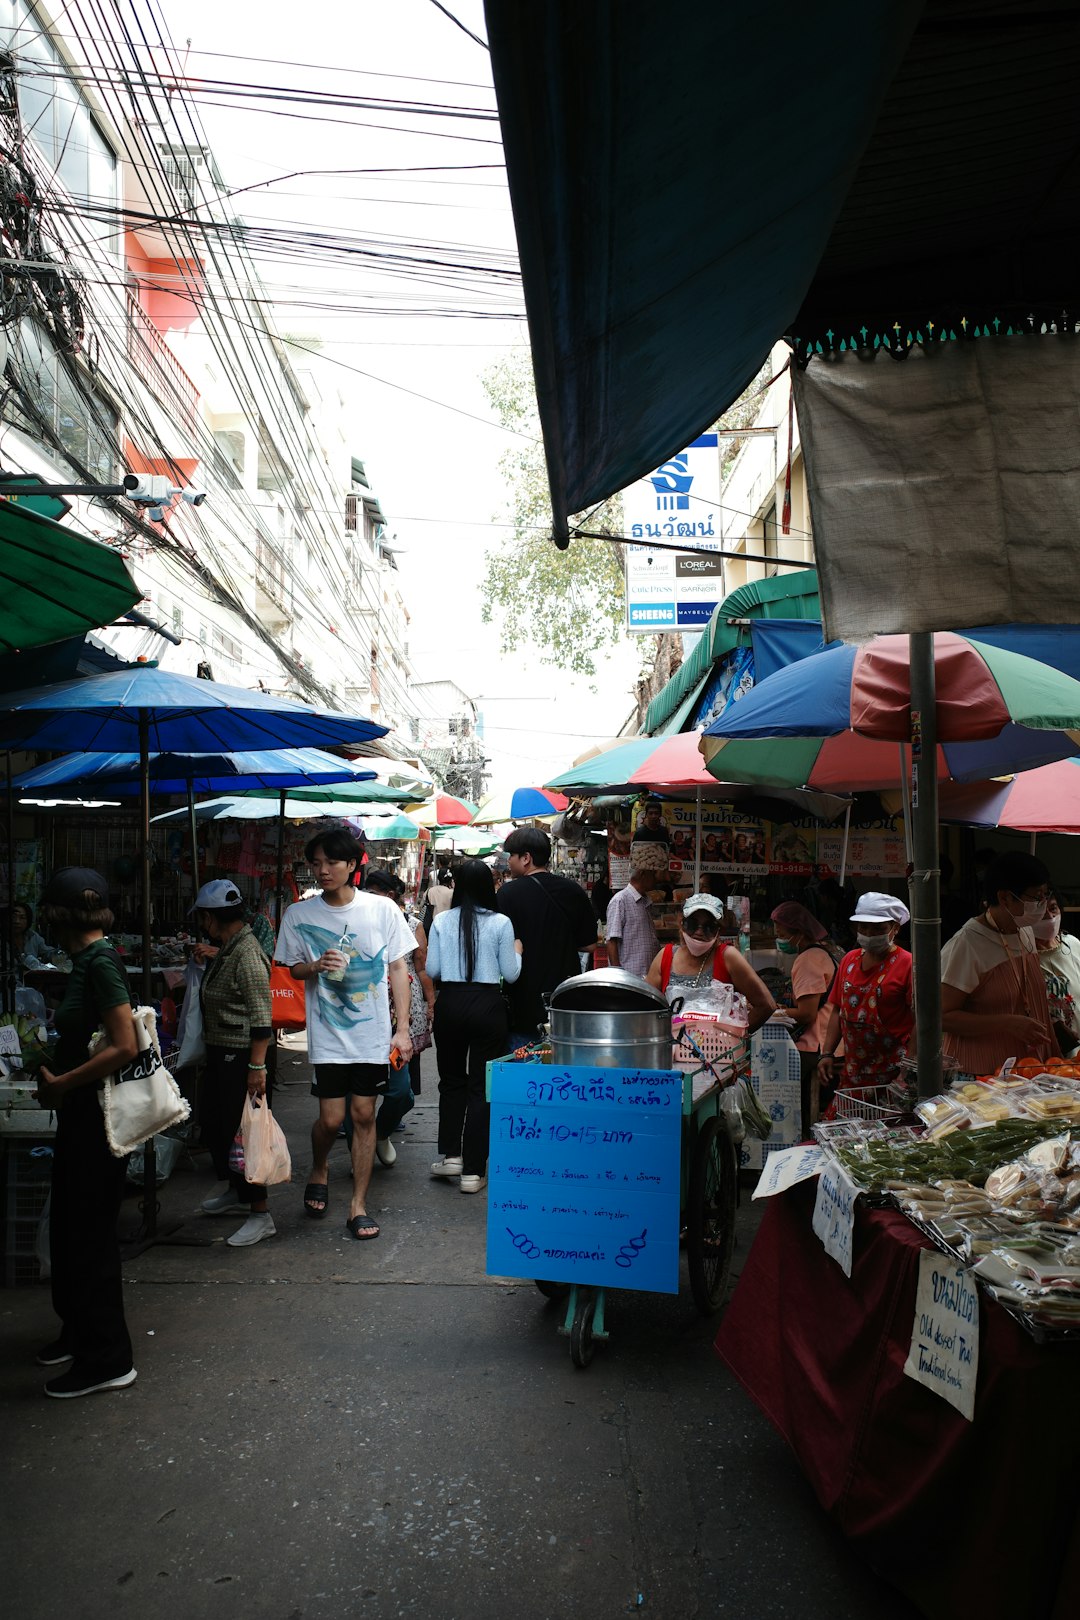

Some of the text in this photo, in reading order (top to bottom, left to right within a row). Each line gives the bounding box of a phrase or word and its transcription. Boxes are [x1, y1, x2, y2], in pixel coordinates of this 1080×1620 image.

[631, 513, 715, 538] ธนวัฒน์
[631, 585, 673, 593] Cute Press
[270, 989, 295, 999] THER
[549, 1125, 598, 1145] 10-15
[602, 1131, 633, 1144] บาท
[919, 1313, 934, 1339] Old
